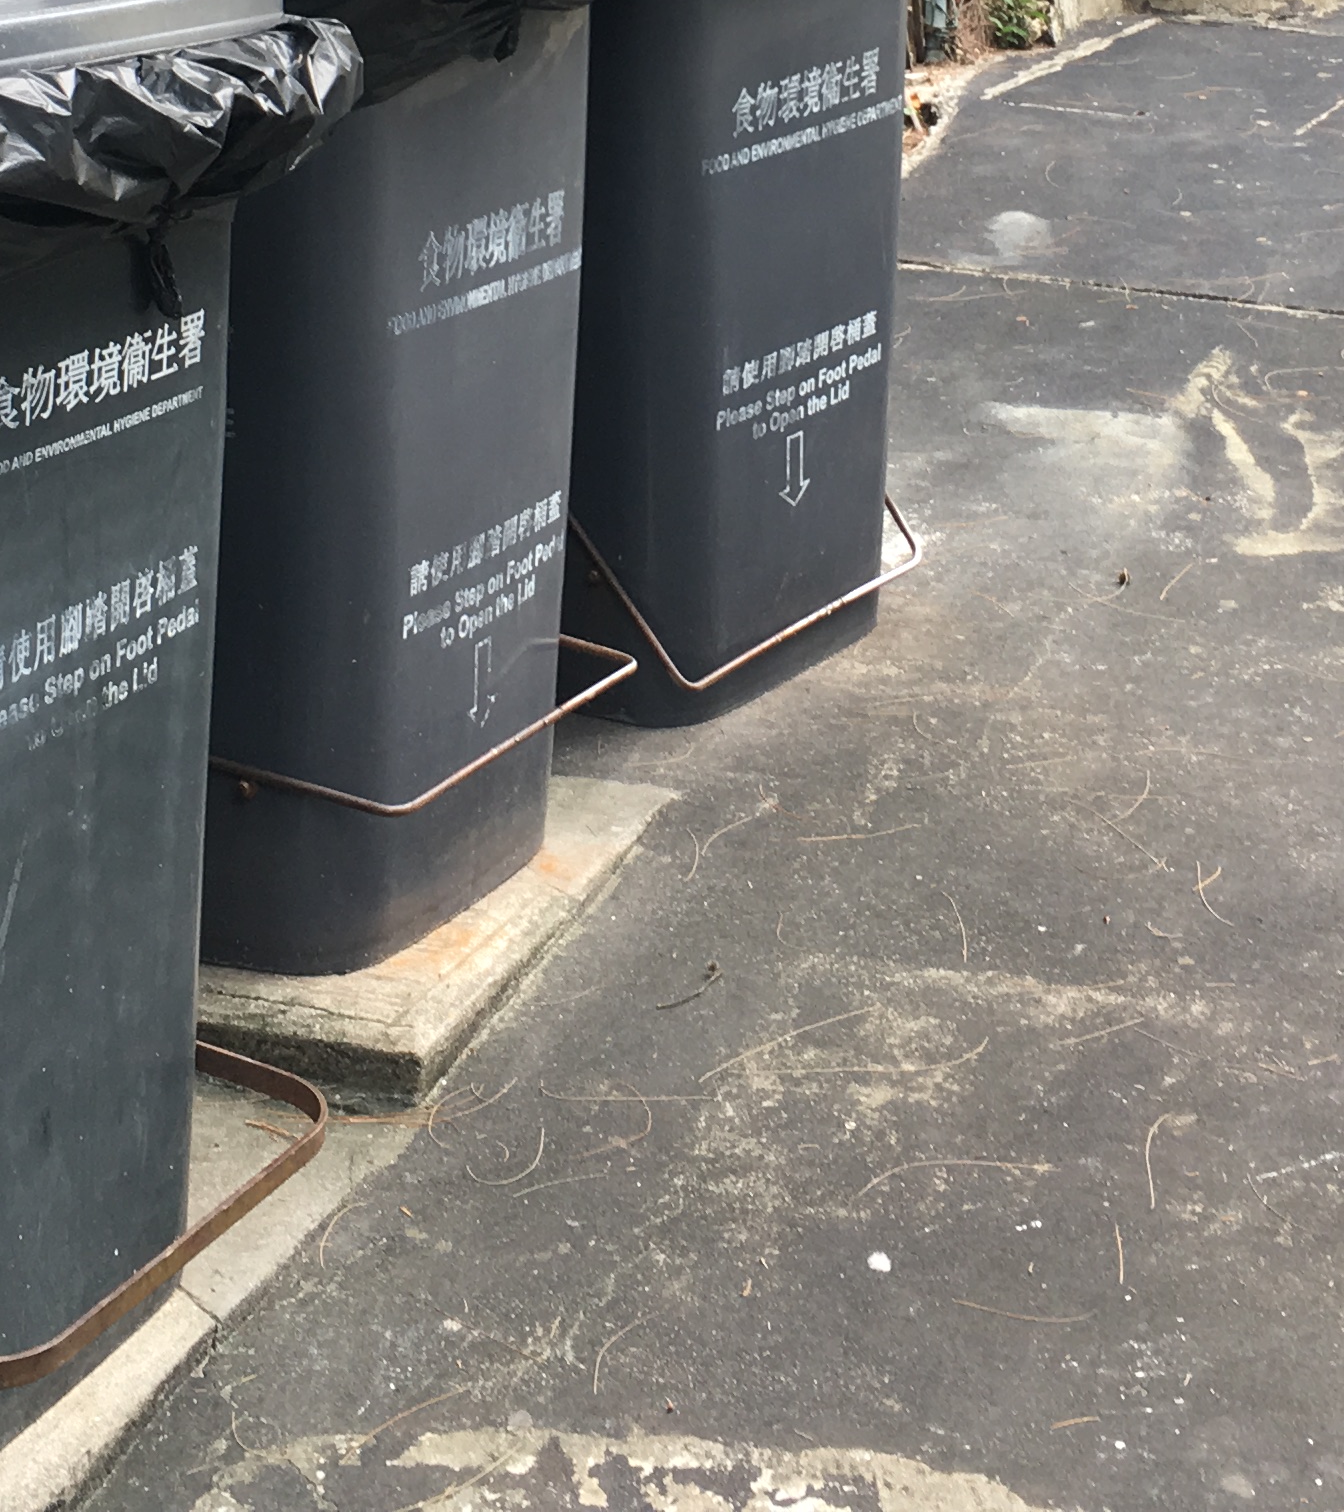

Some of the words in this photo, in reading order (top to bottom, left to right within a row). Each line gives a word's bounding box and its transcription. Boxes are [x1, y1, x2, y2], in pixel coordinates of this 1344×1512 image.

[730, 148, 750, 169] AND
[751, 125, 821, 162] ENVIRONMENTAL
[716, 400, 763, 431] Please
[766, 385, 796, 410] Step
[799, 377, 815, 397] on
[818, 360, 847, 388] Foot
[849, 342, 882, 375] Pedal
[752, 421, 767, 440] to
[769, 405, 805, 432] Open
[807, 394, 827, 415] the
[830, 379, 850, 405] Lid
[11, 451, 34, 471] AND
[35, 422, 113, 463] ENVIRONMENTAL
[114, 406, 150, 434] HYGIENE
[151, 386, 204, 418] DEPARTMENT
[402, 600, 451, 640] Please
[455, 582, 485, 613] Step
[488, 572, 504, 595] on
[507, 550, 534, 585] Foot
[440, 626, 455, 649] to
[458, 605, 493, 639] Open
[495, 593, 515, 619] the
[517, 574, 536, 610] Lid
[44, 666, 85, 705] Step
[89, 653, 111, 681] on
[116, 625, 154, 668] Foot
[157, 598, 200, 645] Pedal
[102, 679, 129, 710] the
